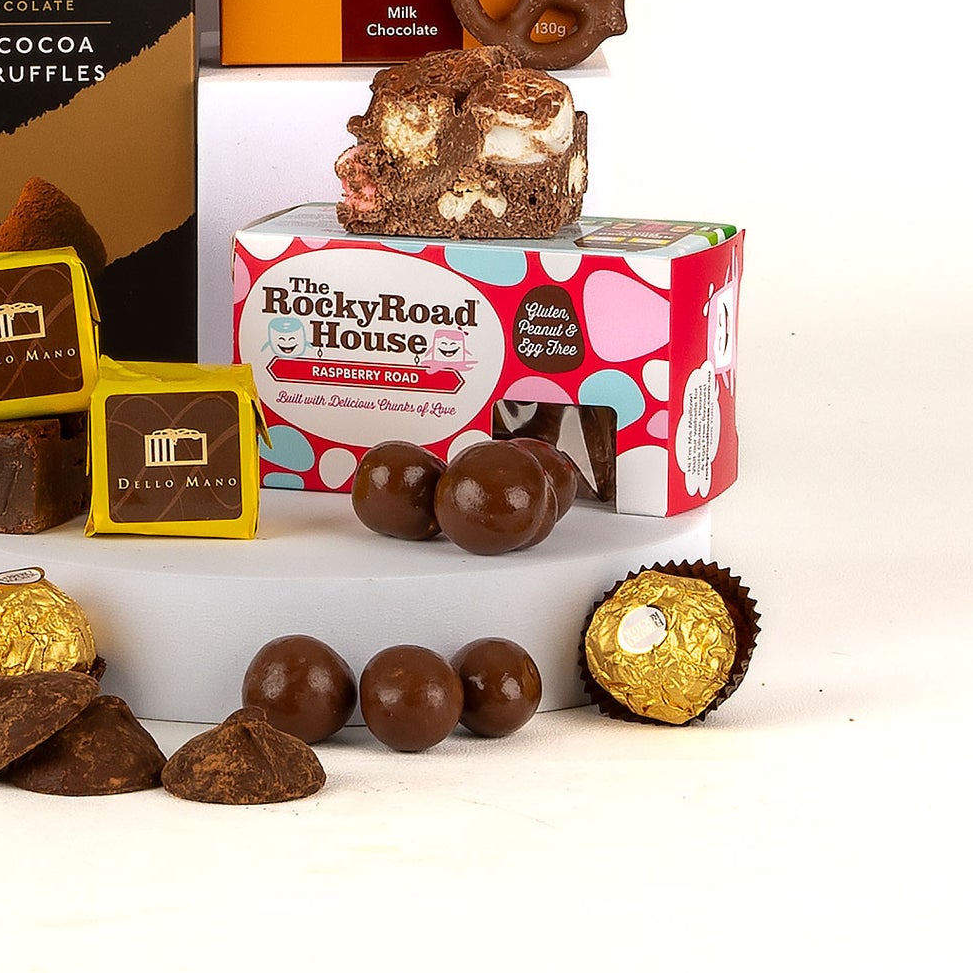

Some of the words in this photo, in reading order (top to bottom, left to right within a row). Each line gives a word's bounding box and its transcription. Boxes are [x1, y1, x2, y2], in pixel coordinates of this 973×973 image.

[388, 6, 417, 18] Milk
[367, 23, 437, 35] Chocolate
[535, 22, 566, 37] 130g
[287, 277, 329, 297] The
[525, 302, 569, 321] Gluten,
[519, 319, 563, 337] Peanut
[565, 324, 578, 337] &
[310, 320, 427, 355] House
[518, 337, 544, 357] Egg
[546, 340, 577, 355] Free
[312, 366, 381, 381] RASPBERRY
[385, 371, 418, 383] ROAD
[276, 391, 305, 404] Built
[302, 396, 329, 405] with
[328, 396, 376, 409] Delicious
[375, 399, 415, 412] Chunks
[416, 403, 429, 417] of
[428, 403, 456, 417] Love
